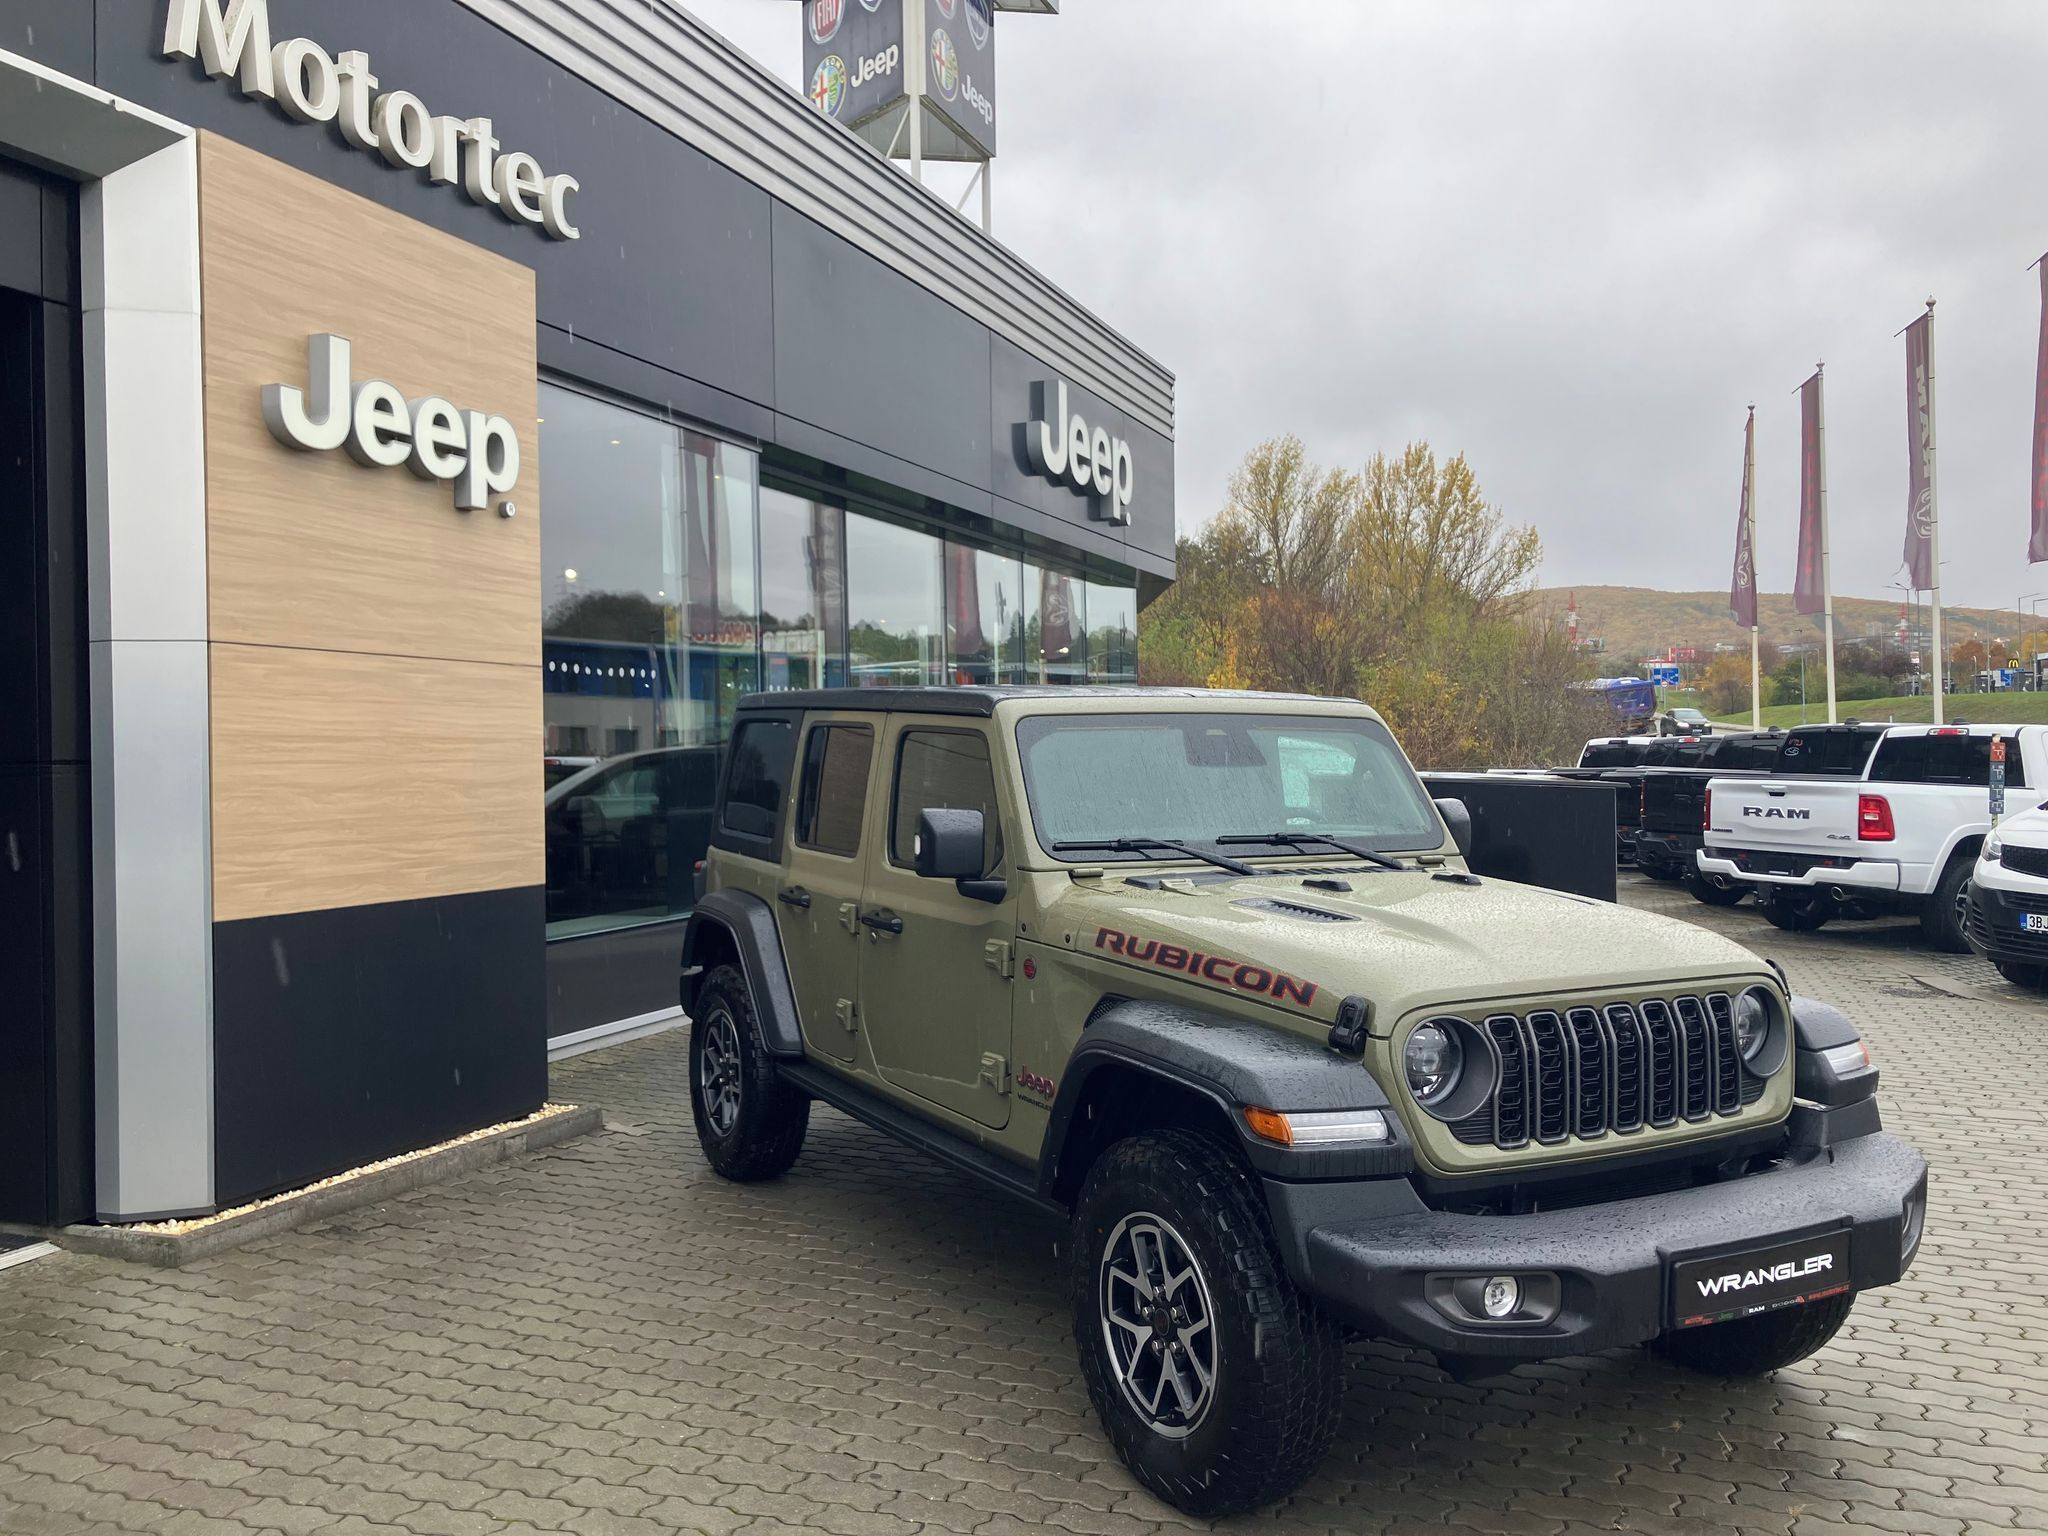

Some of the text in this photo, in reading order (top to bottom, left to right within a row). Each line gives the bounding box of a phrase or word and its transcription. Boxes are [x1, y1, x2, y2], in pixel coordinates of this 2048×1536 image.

[851, 44, 899, 88] Jeep
[163, 0, 581, 241] Motortec
[961, 74, 993, 125] Jeep
[260, 332, 520, 511] Jeep
[1028, 378, 1133, 520] Jeep
[1743, 806, 1810, 819] RAM
[1095, 927, 1319, 1008] RUBICON
[1016, 1064, 1056, 1102] Jeep
[1697, 1253, 1833, 1297] WRANGLER
[1748, 1305, 1766, 1314] RAM
